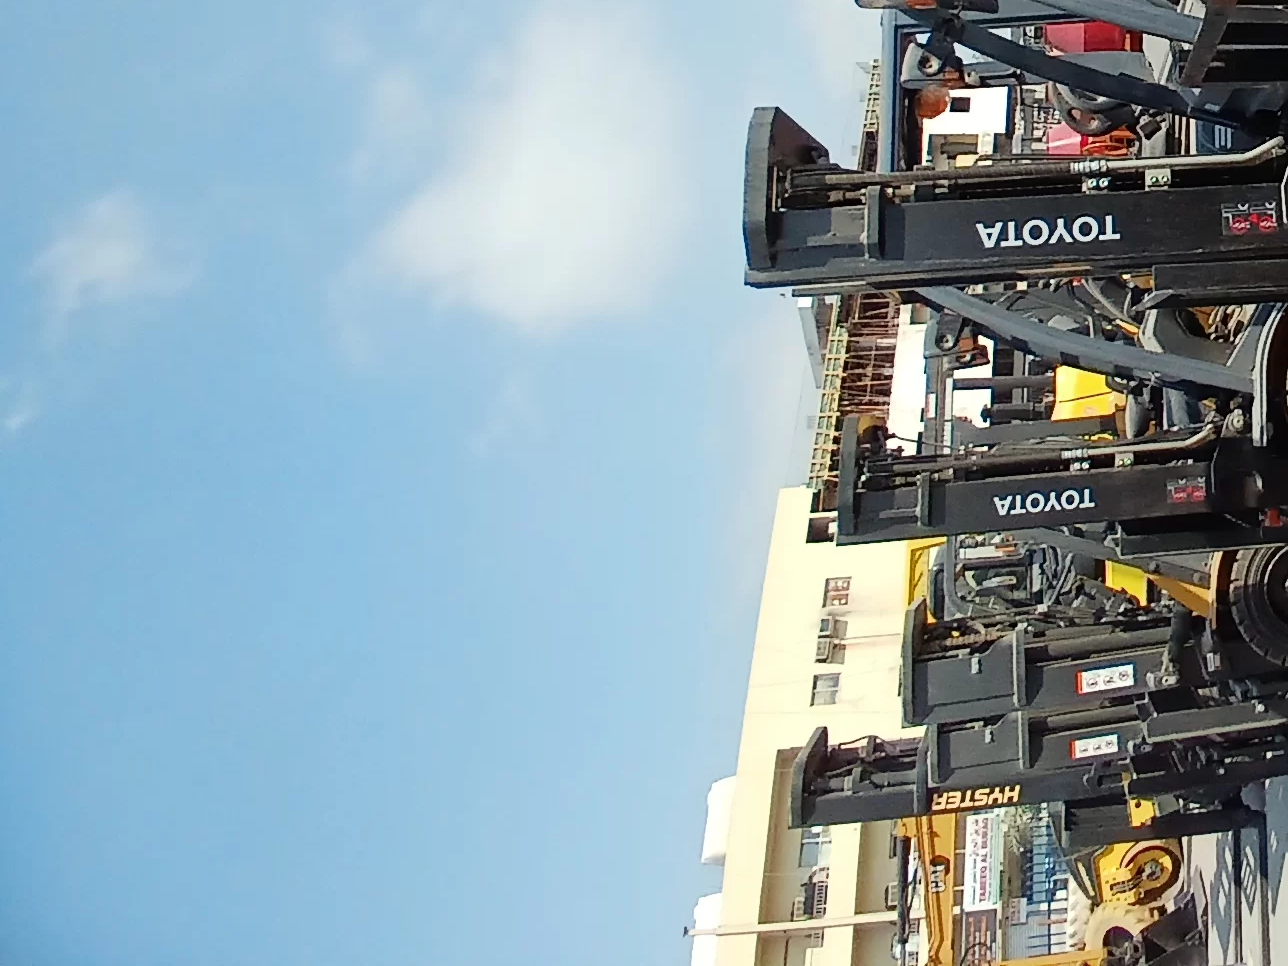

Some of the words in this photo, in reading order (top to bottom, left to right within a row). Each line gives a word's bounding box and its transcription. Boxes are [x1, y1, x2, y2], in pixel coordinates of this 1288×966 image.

[976, 214, 1121, 248] TOYOTA
[993, 486, 1096, 517] TOYOTA
[931, 784, 1021, 811] HYSTER
